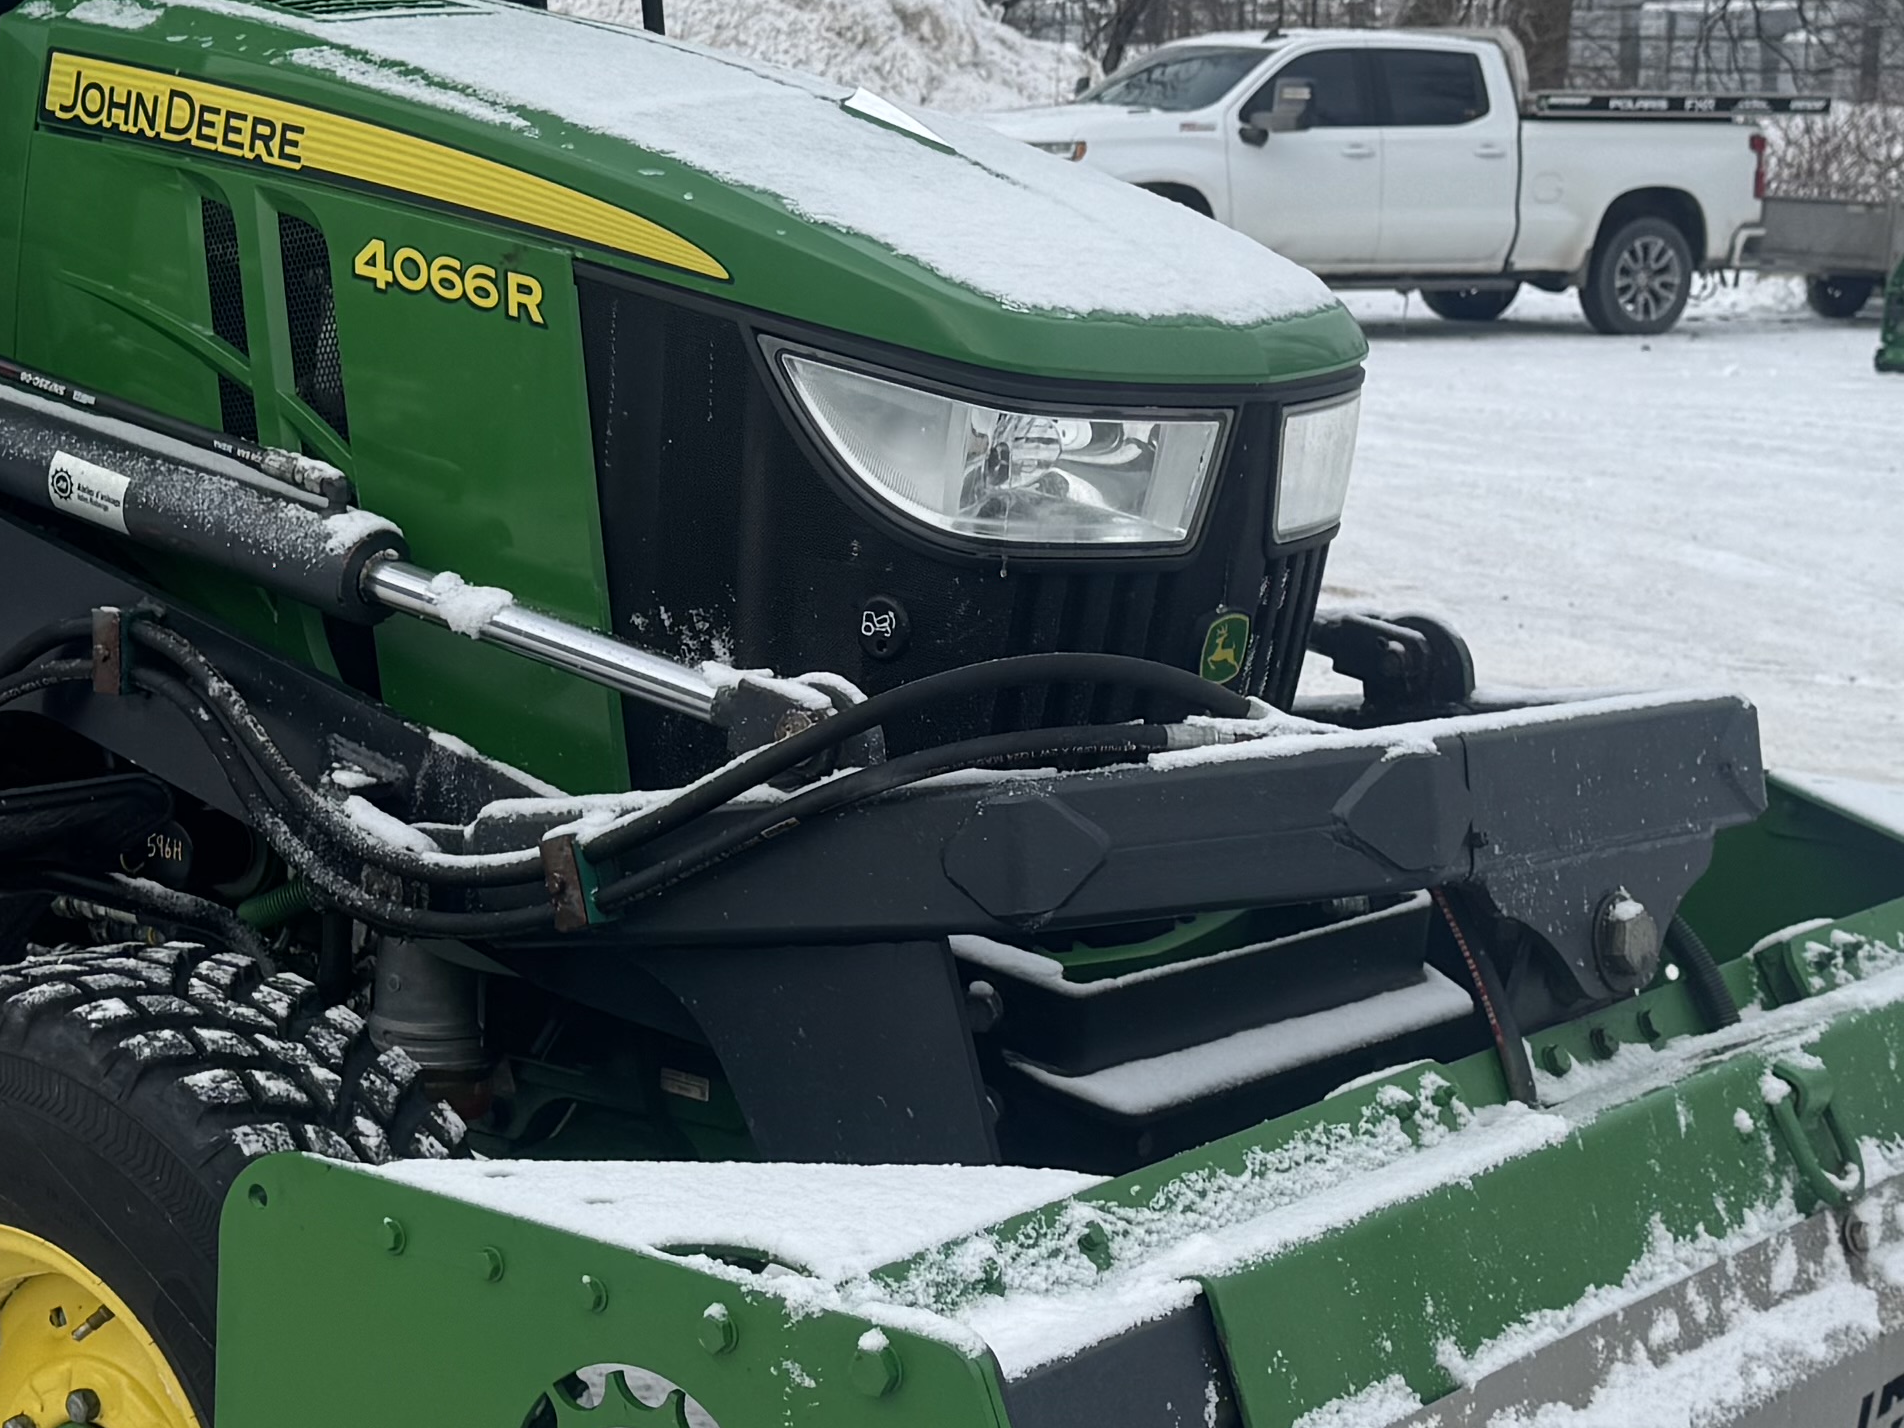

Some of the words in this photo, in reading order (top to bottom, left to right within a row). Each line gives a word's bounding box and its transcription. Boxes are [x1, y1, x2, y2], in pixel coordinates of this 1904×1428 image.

[58, 70, 160, 133] JOHN
[164, 88, 306, 165] DEERE
[353, 237, 547, 326] 4066R
[147, 832, 182, 862] 596H
